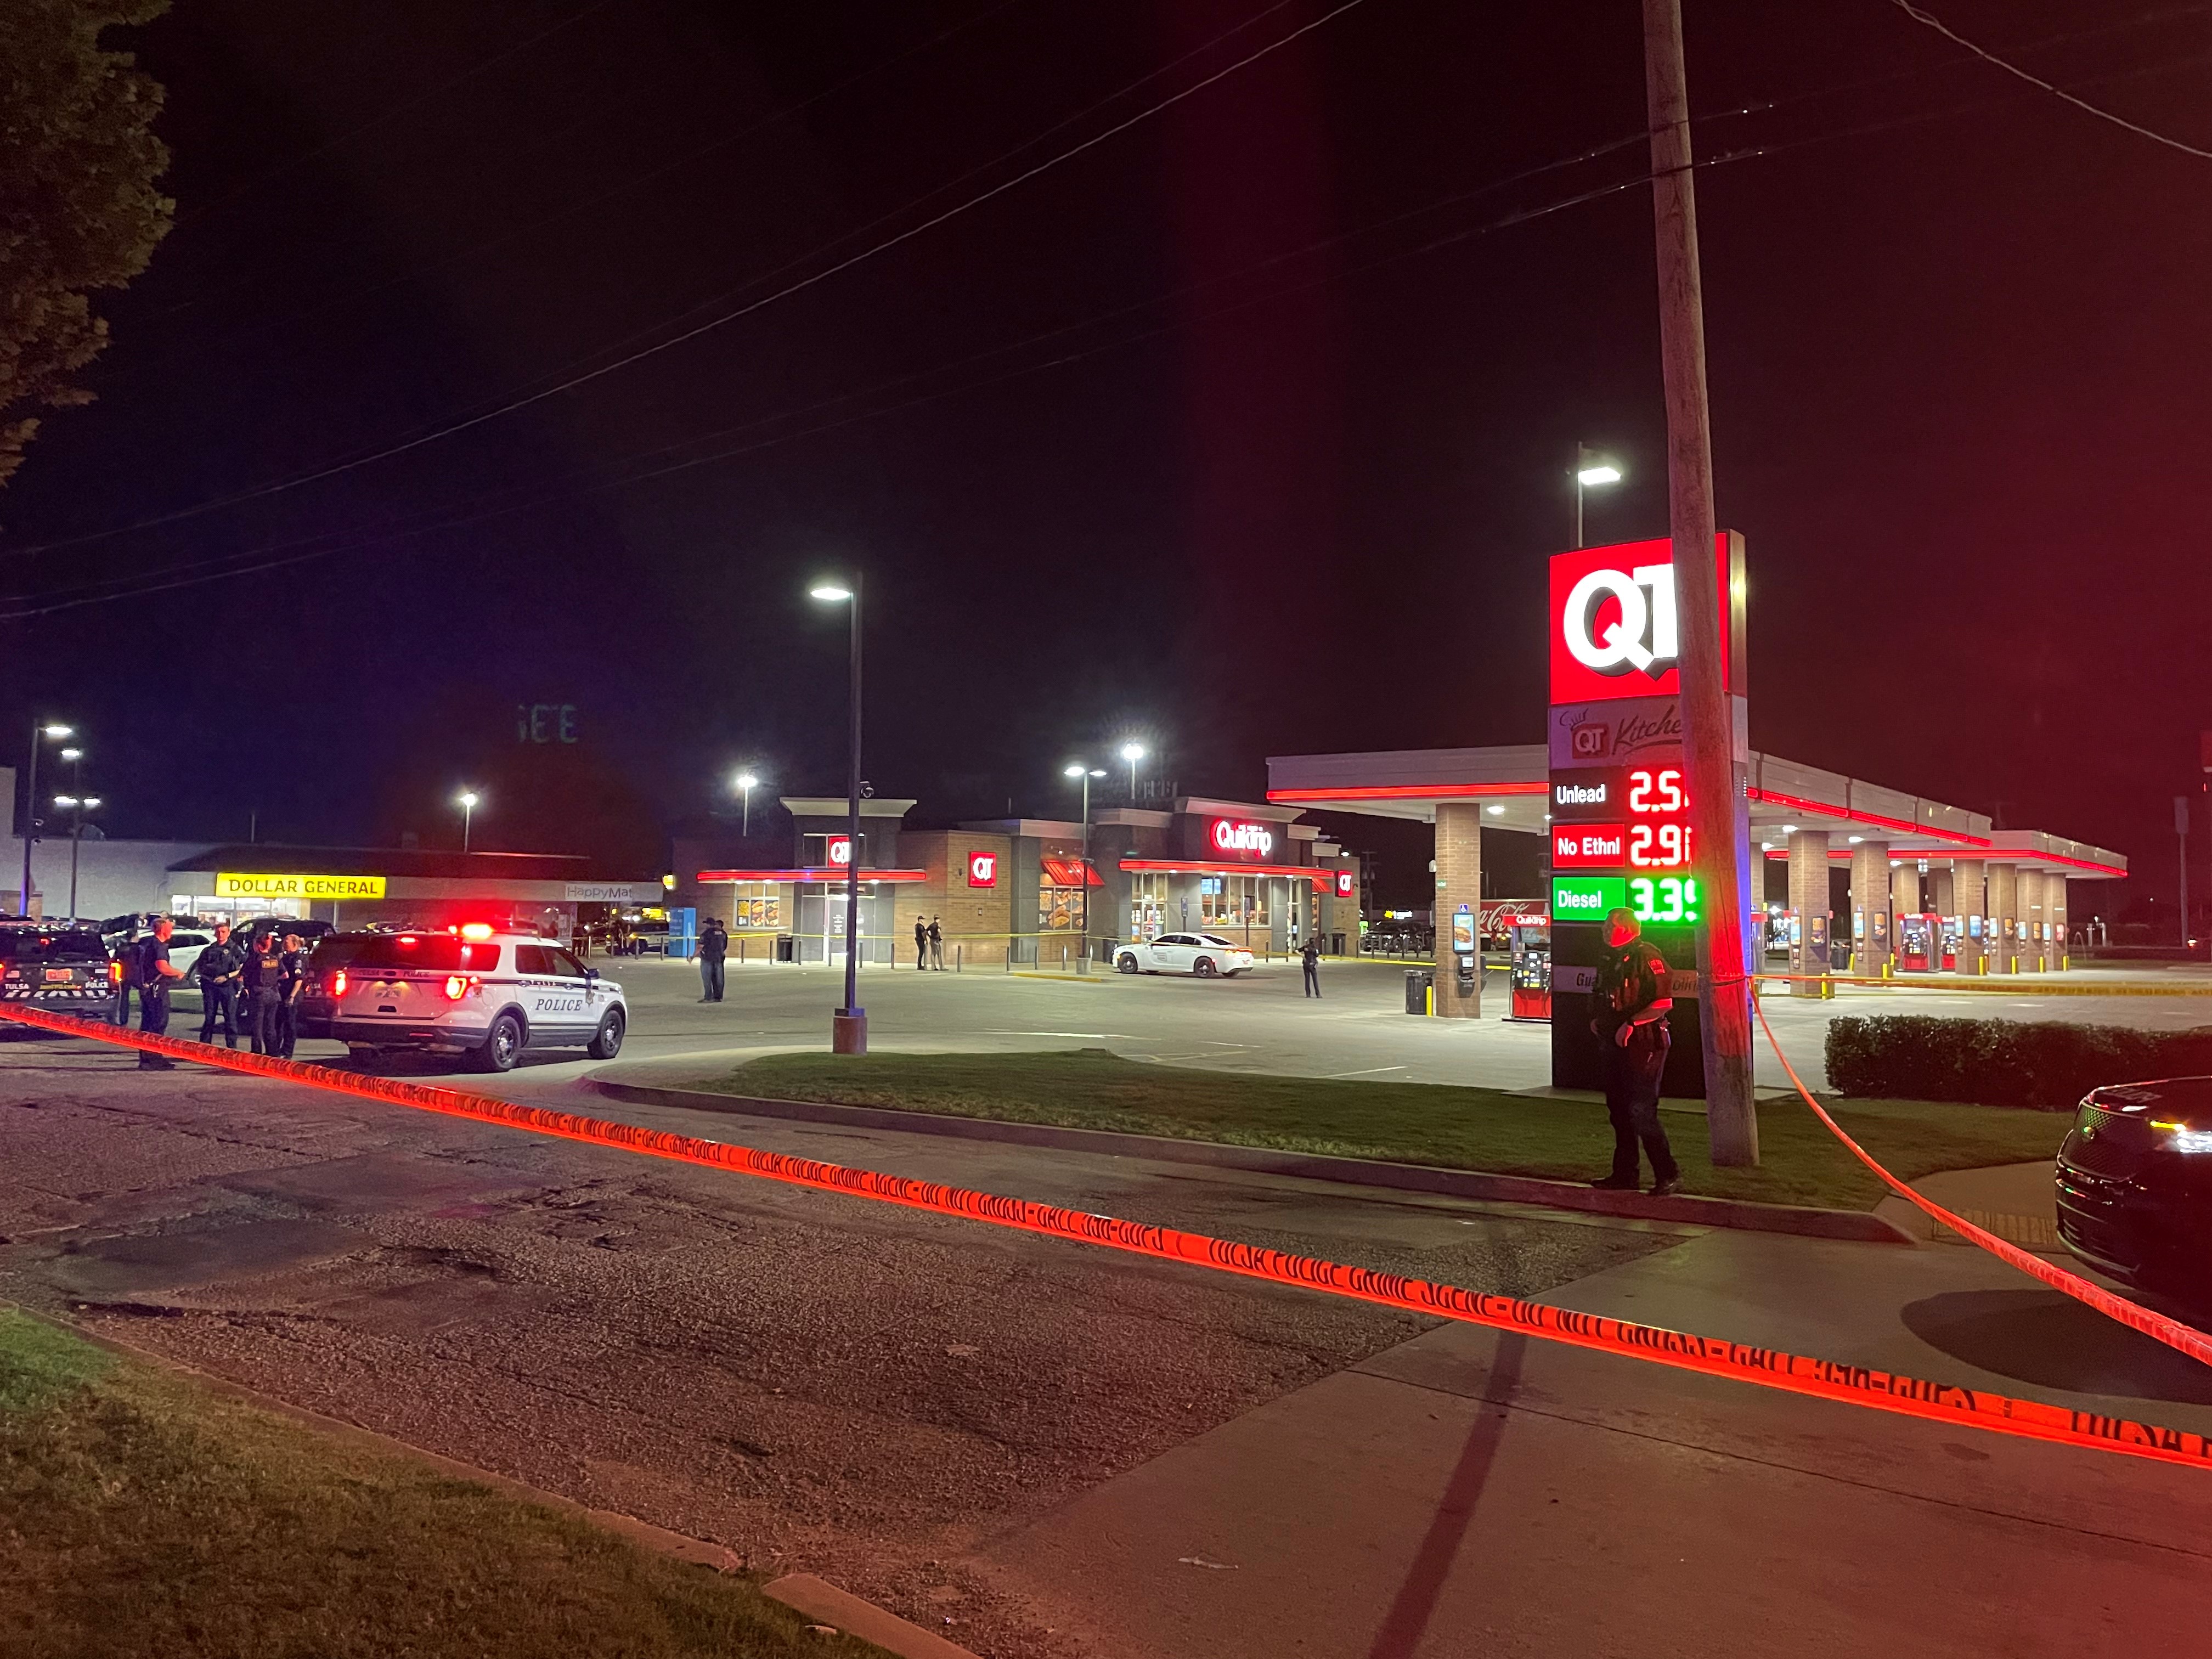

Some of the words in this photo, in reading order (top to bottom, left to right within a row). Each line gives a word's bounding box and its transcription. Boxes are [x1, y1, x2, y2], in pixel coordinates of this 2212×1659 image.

[1564, 563, 1678, 672] QT
[1575, 729, 1604, 752] QT
[1556, 783, 1605, 804] Unlead
[1216, 821, 1272, 856] QuikTrip
[1558, 838, 1577, 856] No
[1583, 837, 1620, 855] Ethnl
[831, 842, 850, 864] QT
[973, 857, 993, 881] QT
[229, 879, 297, 892] DOLLAR
[304, 881, 378, 894] GENERAL
[1339, 874, 1351, 891] QT
[1558, 890, 1602, 908] Diesel
[1516, 916, 1546, 926] QuikTrip
[535, 999, 583, 1011] POLICE
